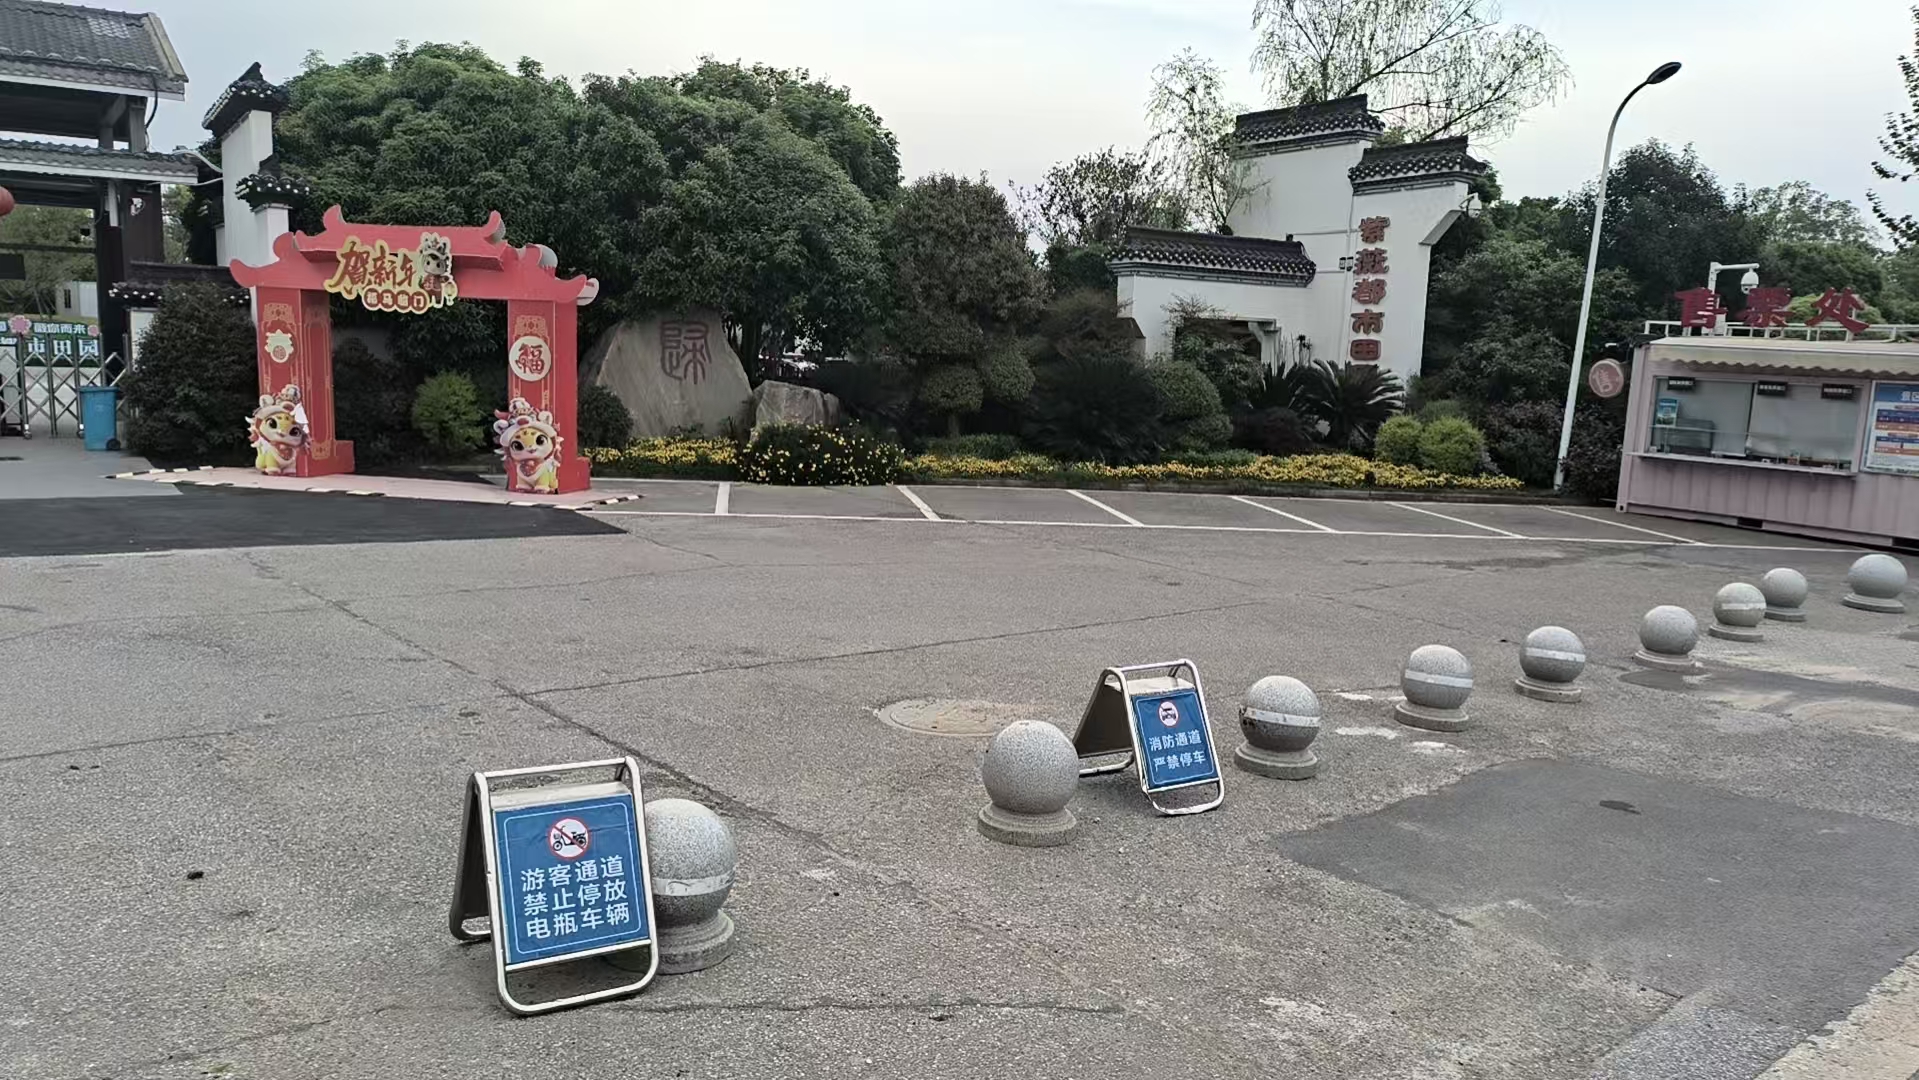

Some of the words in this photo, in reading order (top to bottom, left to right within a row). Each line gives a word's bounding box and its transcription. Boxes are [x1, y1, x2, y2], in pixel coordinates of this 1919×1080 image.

[1345, 216, 1391, 385] 紫薇都市田
[1674, 287, 1870, 334] 售票处
[515, 342, 545, 374] 福
[1149, 730, 1202, 751] 消防通道
[1153, 750, 1206, 772] 严禁停车
[520, 854, 625, 892] 游客通道
[523, 879, 628, 917] 禁止停放
[526, 902, 630, 940] 电瓶车辆
